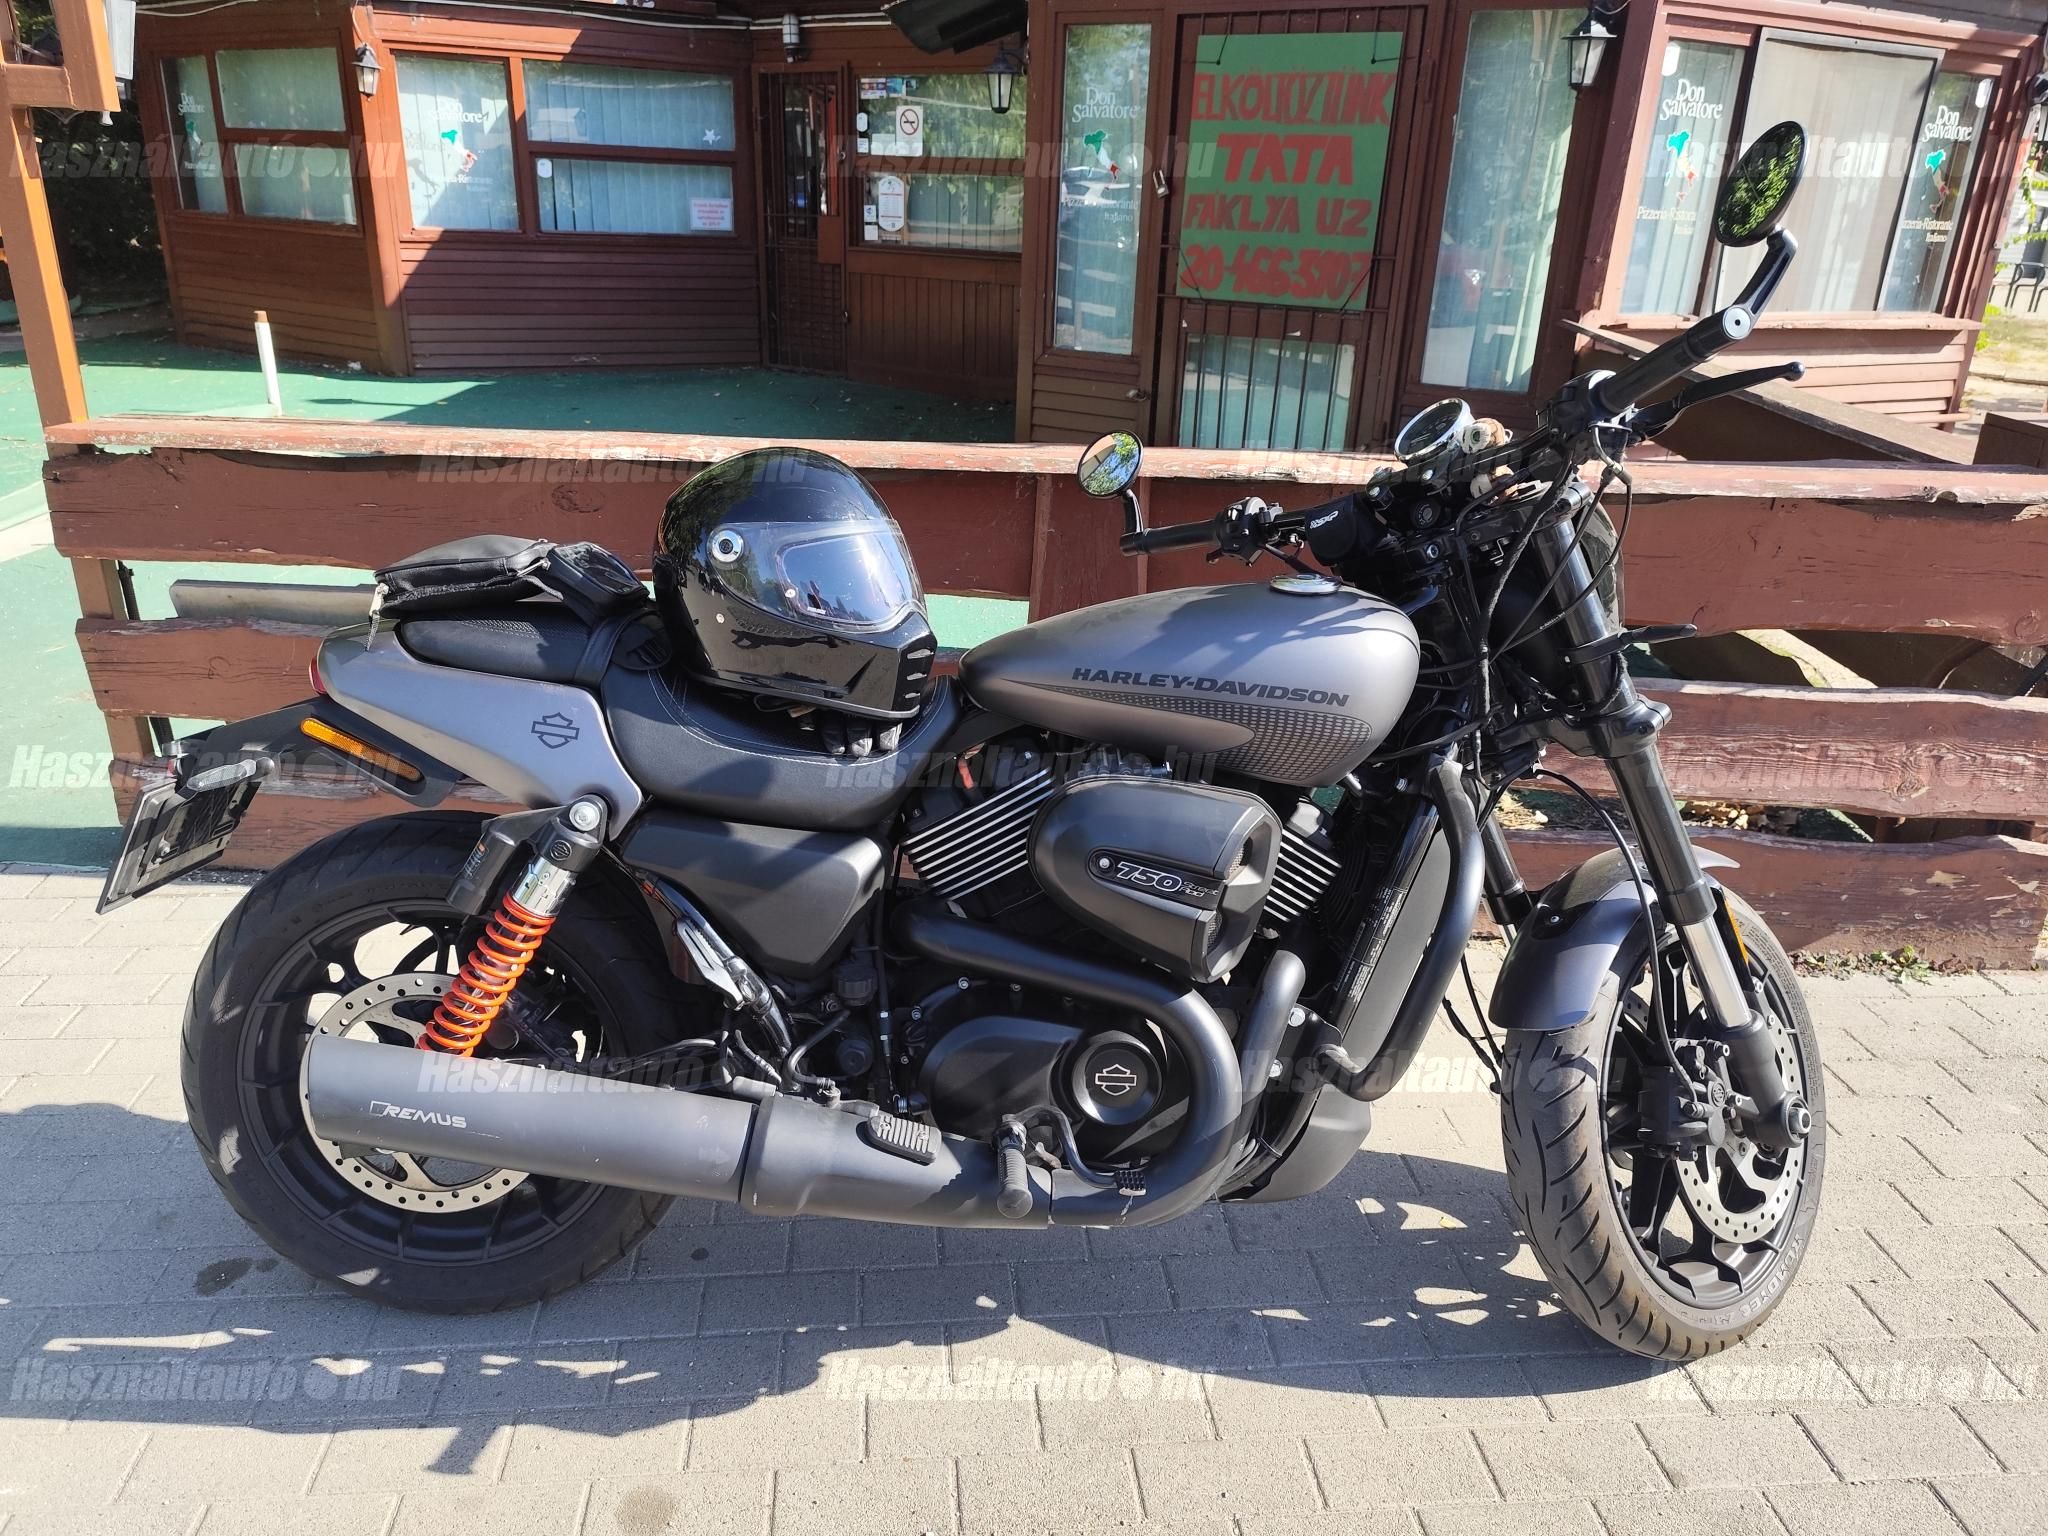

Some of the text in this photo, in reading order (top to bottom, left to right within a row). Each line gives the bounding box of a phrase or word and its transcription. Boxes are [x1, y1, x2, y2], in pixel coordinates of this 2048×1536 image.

[1087, 86, 1116, 105] Don
[1676, 79, 1705, 102] Don
[1072, 103, 1140, 123] Salvatore
[1660, 98, 1723, 121] Salvatore
[1935, 105, 1960, 126] Don
[1922, 122, 1973, 142] Salvatore
[1216, 133, 1355, 186] TATA
[1071, 667, 1350, 708] HARLEY-DAVIDSON
[1118, 861, 1182, 892] 750
[373, 1101, 467, 1129] REMUS
